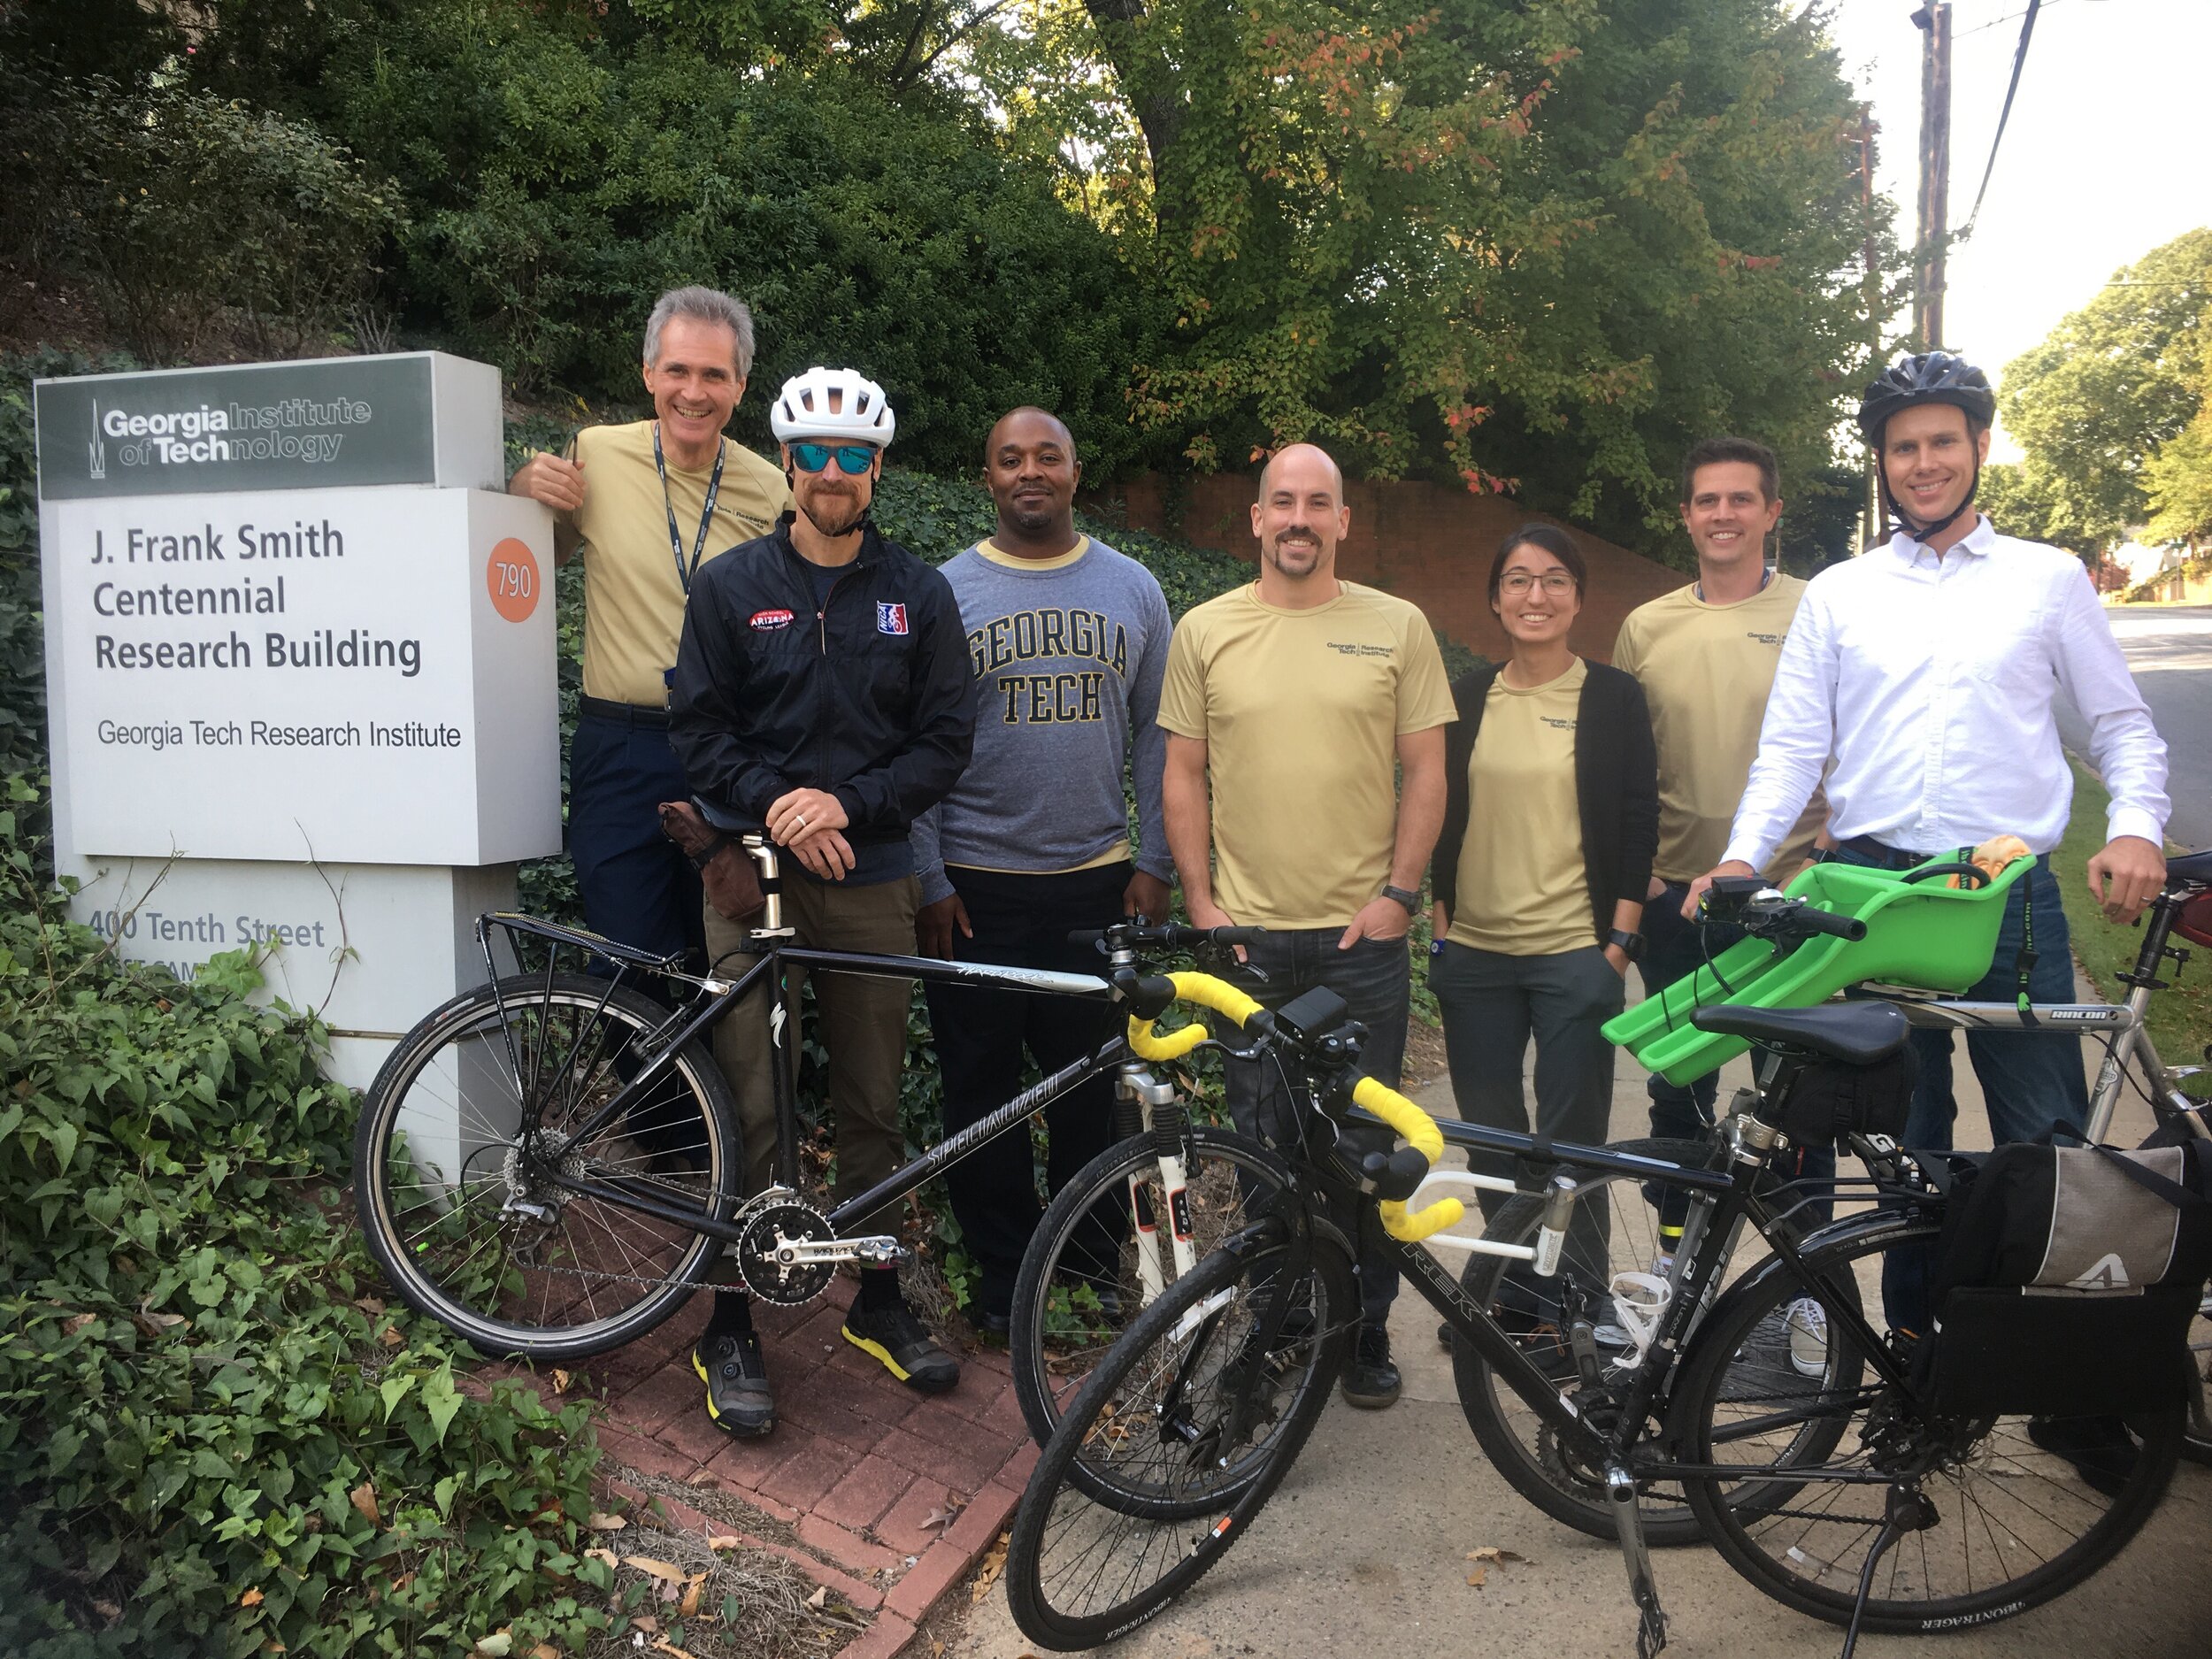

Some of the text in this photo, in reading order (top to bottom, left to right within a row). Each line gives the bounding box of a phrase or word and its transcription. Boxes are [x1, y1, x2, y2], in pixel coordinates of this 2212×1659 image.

[104, 397, 373, 438] Georgia Institute
[119, 430, 344, 466] of Technology
[91, 519, 345, 565] J. Frank Smith
[93, 576, 286, 617] Centennial
[495, 561, 532, 599] 790
[750, 613, 795, 626] ARIZONA
[879, 605, 888, 631] NICA
[96, 629, 421, 677] Research Building
[967, 608, 1128, 680] GEORGIA
[1326, 641, 1356, 650] Georgia
[998, 672, 1105, 725] TECH
[97, 719, 461, 751] Georgia Tech Research Institute
[89, 910, 325, 948] 400 Tenth Street
[2051, 1010, 2107, 1019] RINCON
[927, 1072, 1059, 1171] SPECIALIZED
[1385, 1231, 1482, 1322] REK
[1921, 1606, 2014, 1629] BONTRAGER
